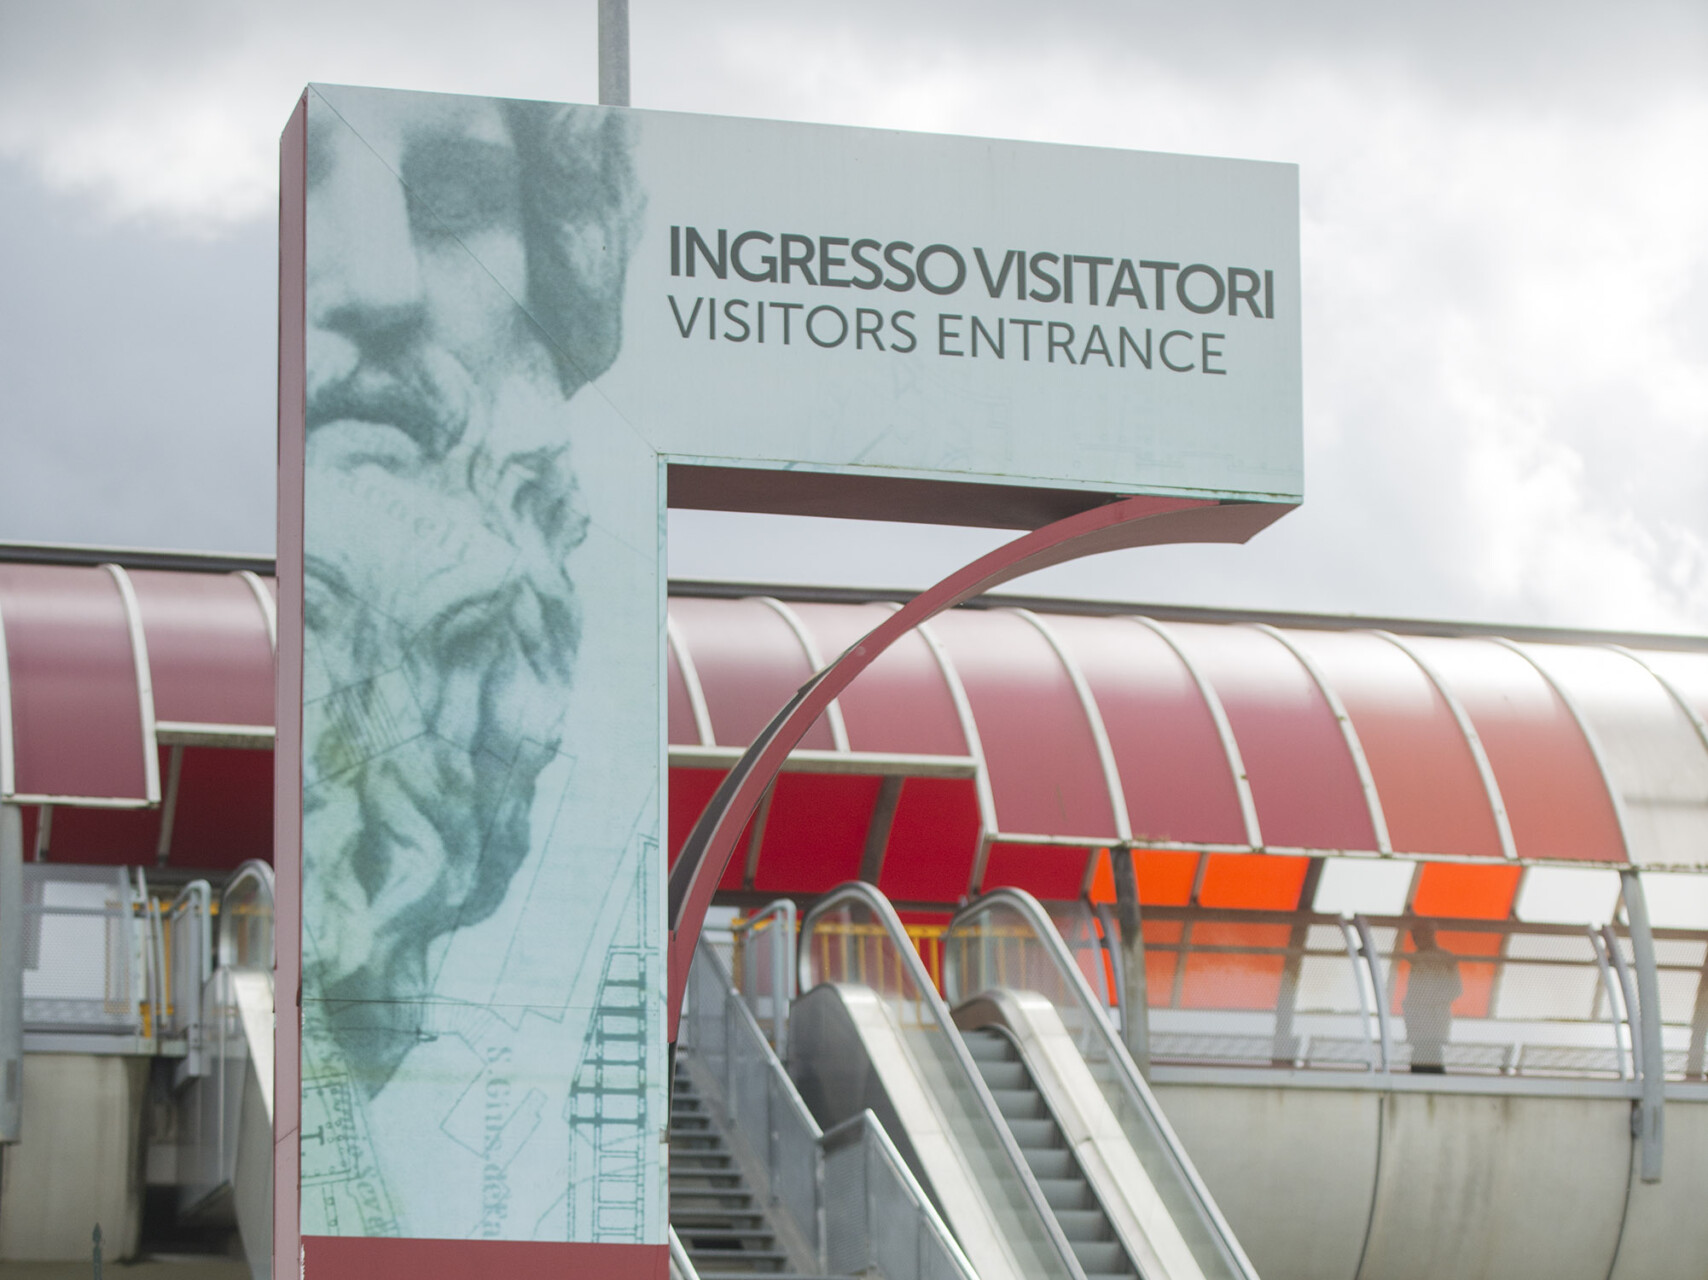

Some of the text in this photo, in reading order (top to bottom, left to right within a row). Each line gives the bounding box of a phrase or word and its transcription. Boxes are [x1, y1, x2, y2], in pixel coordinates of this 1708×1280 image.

[669, 225, 1275, 319] INGRESSO VISITATORI
[667, 295, 1228, 375] VISITORS ENTRANCE
